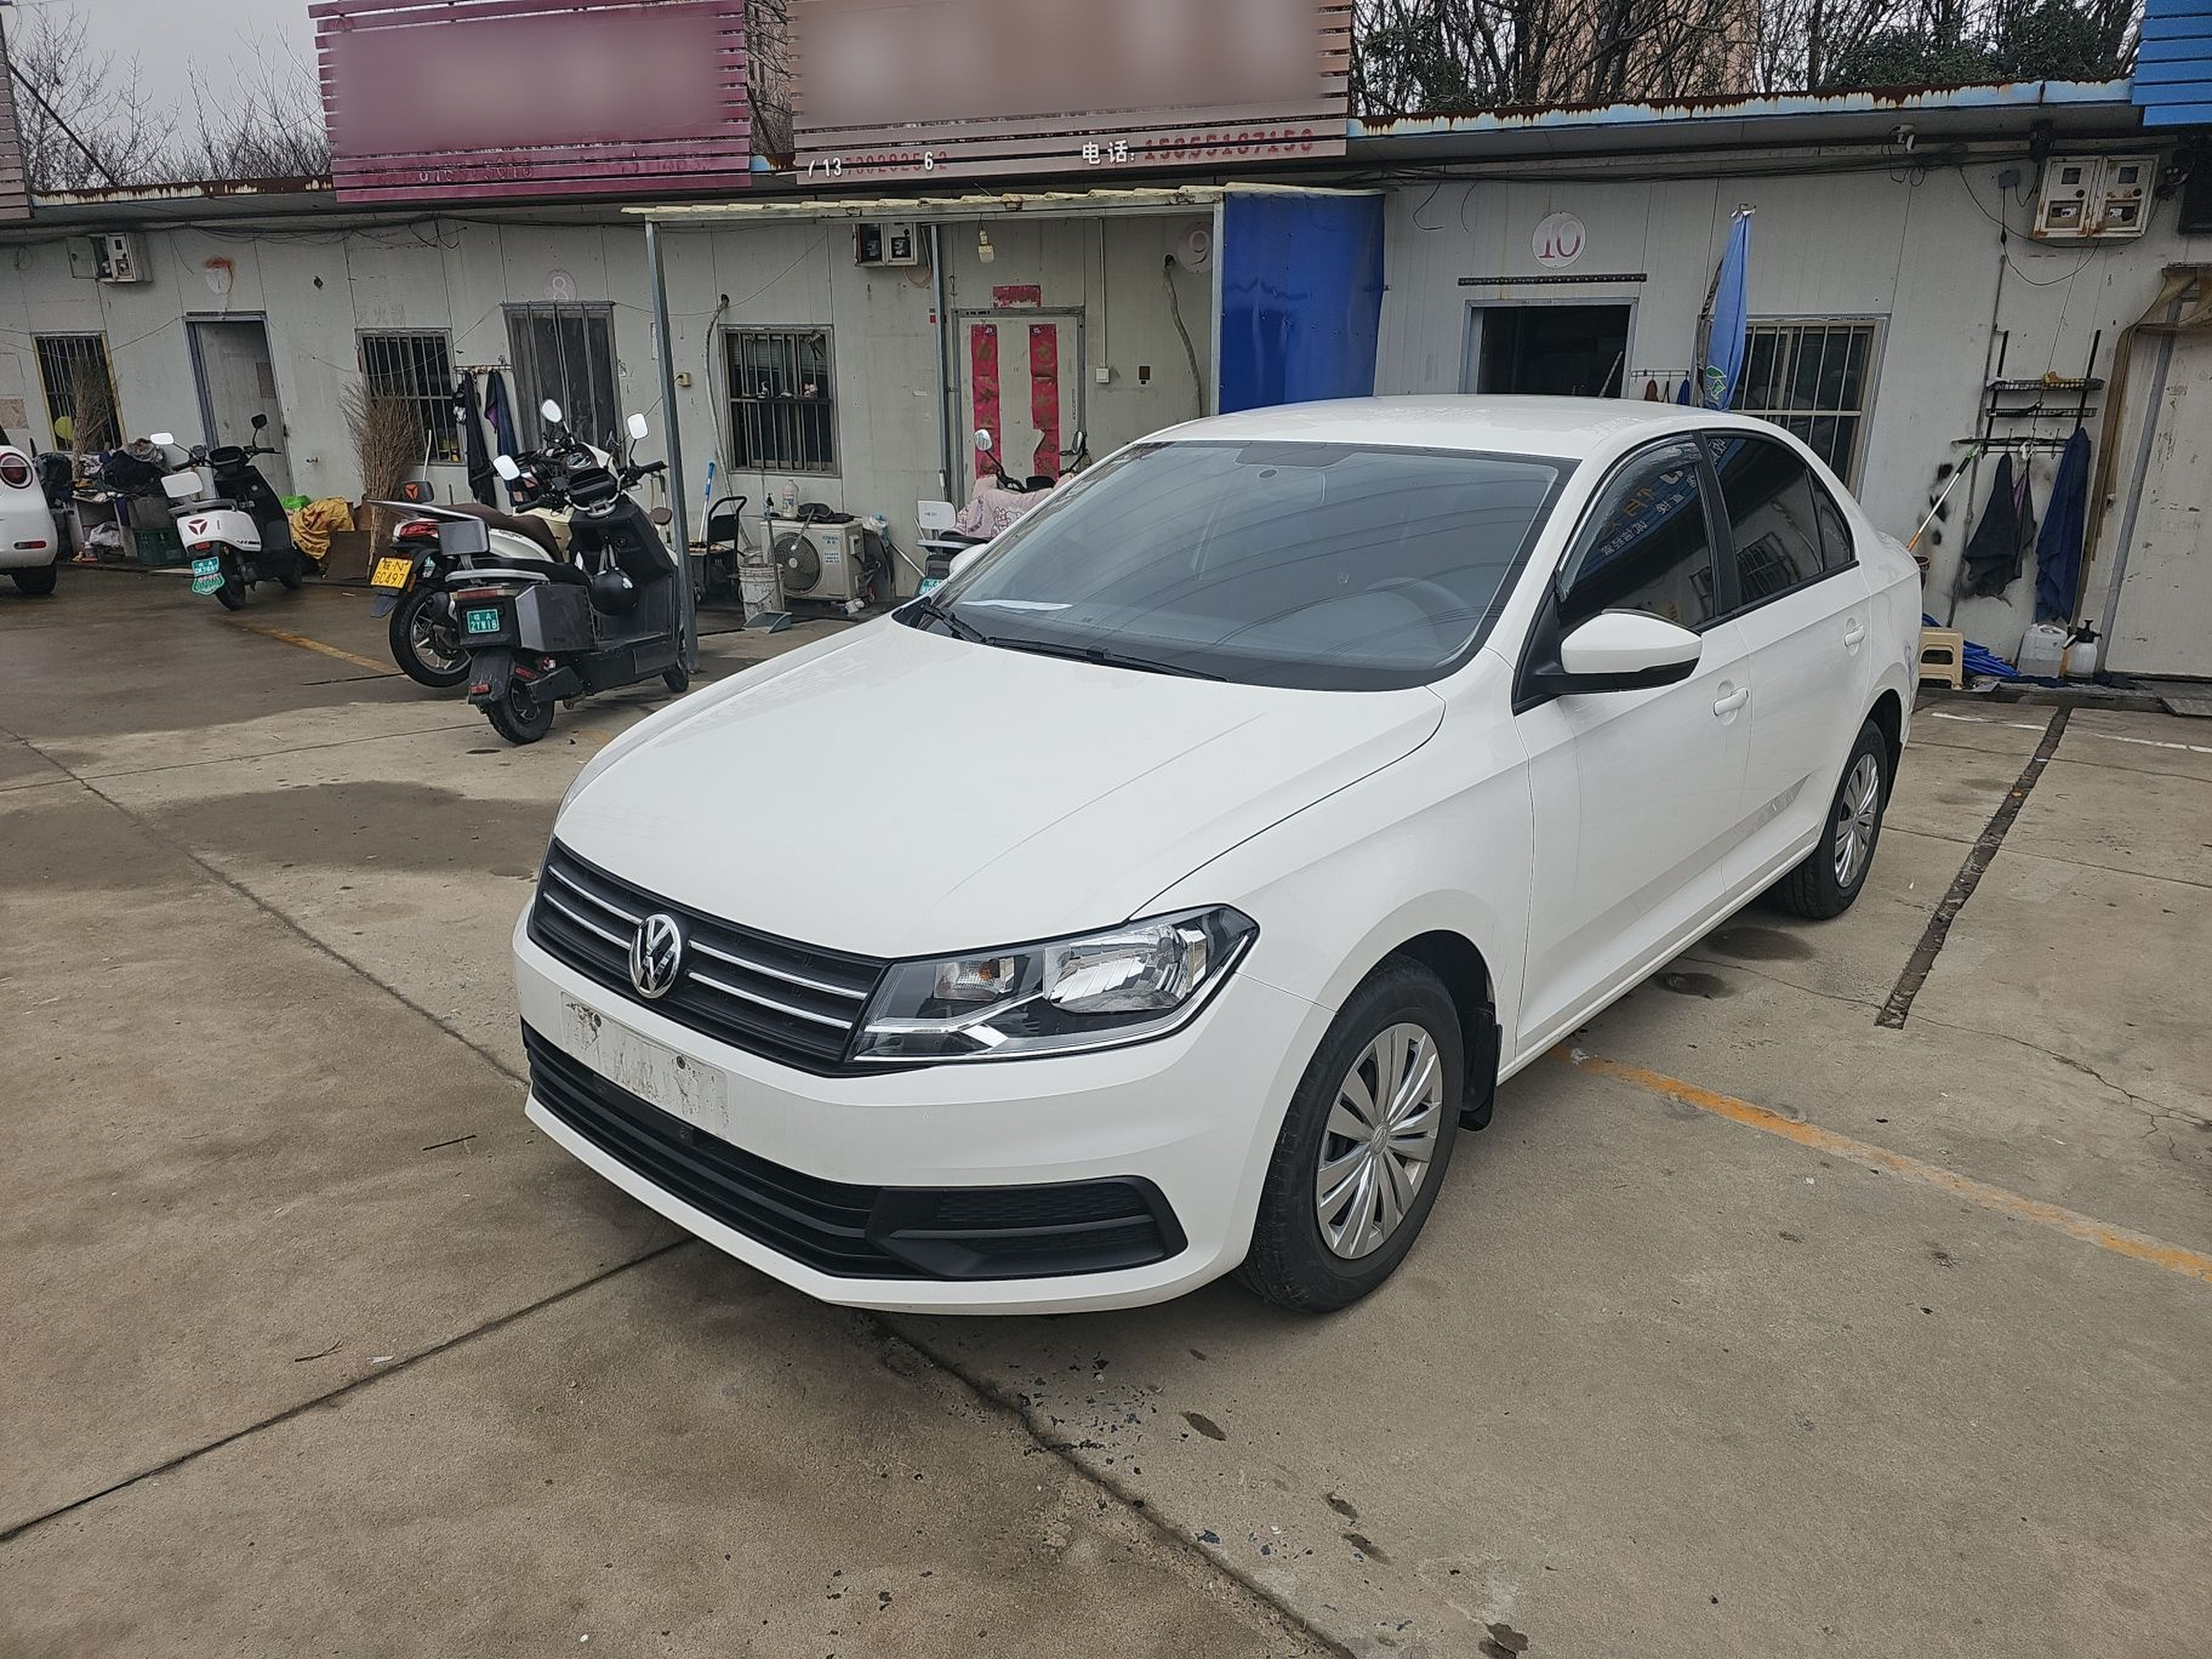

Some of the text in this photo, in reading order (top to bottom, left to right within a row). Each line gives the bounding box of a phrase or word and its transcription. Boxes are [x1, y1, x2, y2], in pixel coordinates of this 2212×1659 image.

[1082, 139, 1135, 164] 电话:
[1537, 220, 1581, 259] 10
[552, 276, 569, 301] 8
